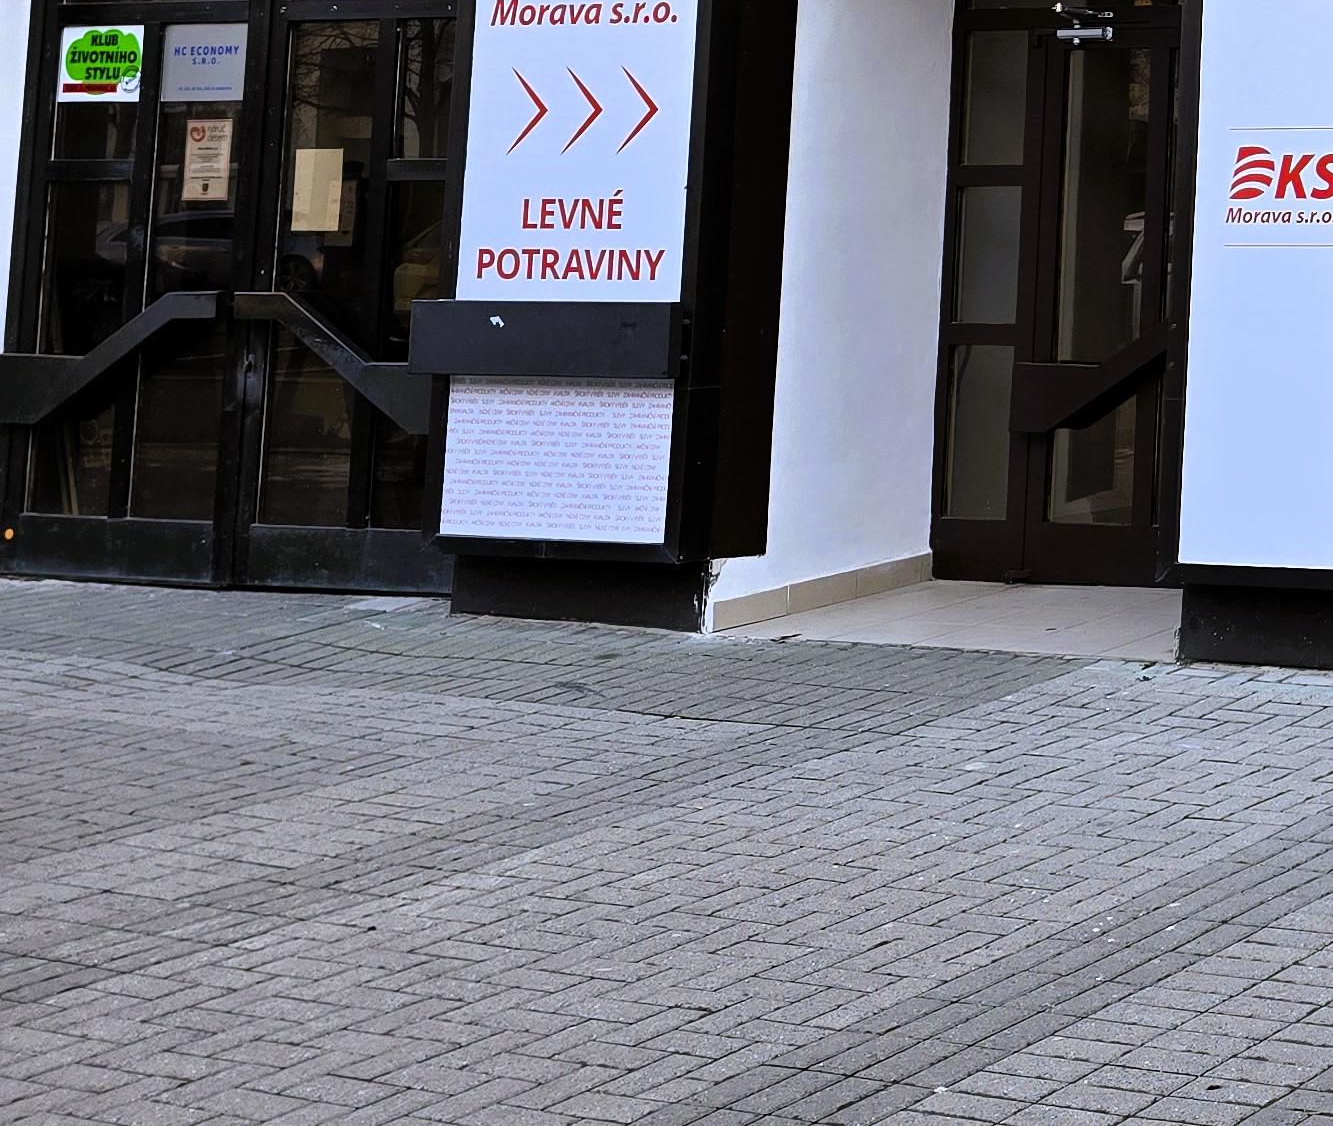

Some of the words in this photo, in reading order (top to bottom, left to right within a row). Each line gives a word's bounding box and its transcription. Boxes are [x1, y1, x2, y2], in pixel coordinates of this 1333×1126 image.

[610, 1, 678, 24] s.r.o.
[91, 34, 119, 46] KLUB
[70, 47, 137, 64] ŽIVOTNÍHO
[174, 45, 187, 56] HC
[190, 45, 239, 57] ECONOMY
[85, 66, 120, 80] STYLU
[521, 191, 624, 230] LEVNÉ
[1225, 206, 1292, 226] Morava
[476, 248, 665, 281] POTRAVINY
